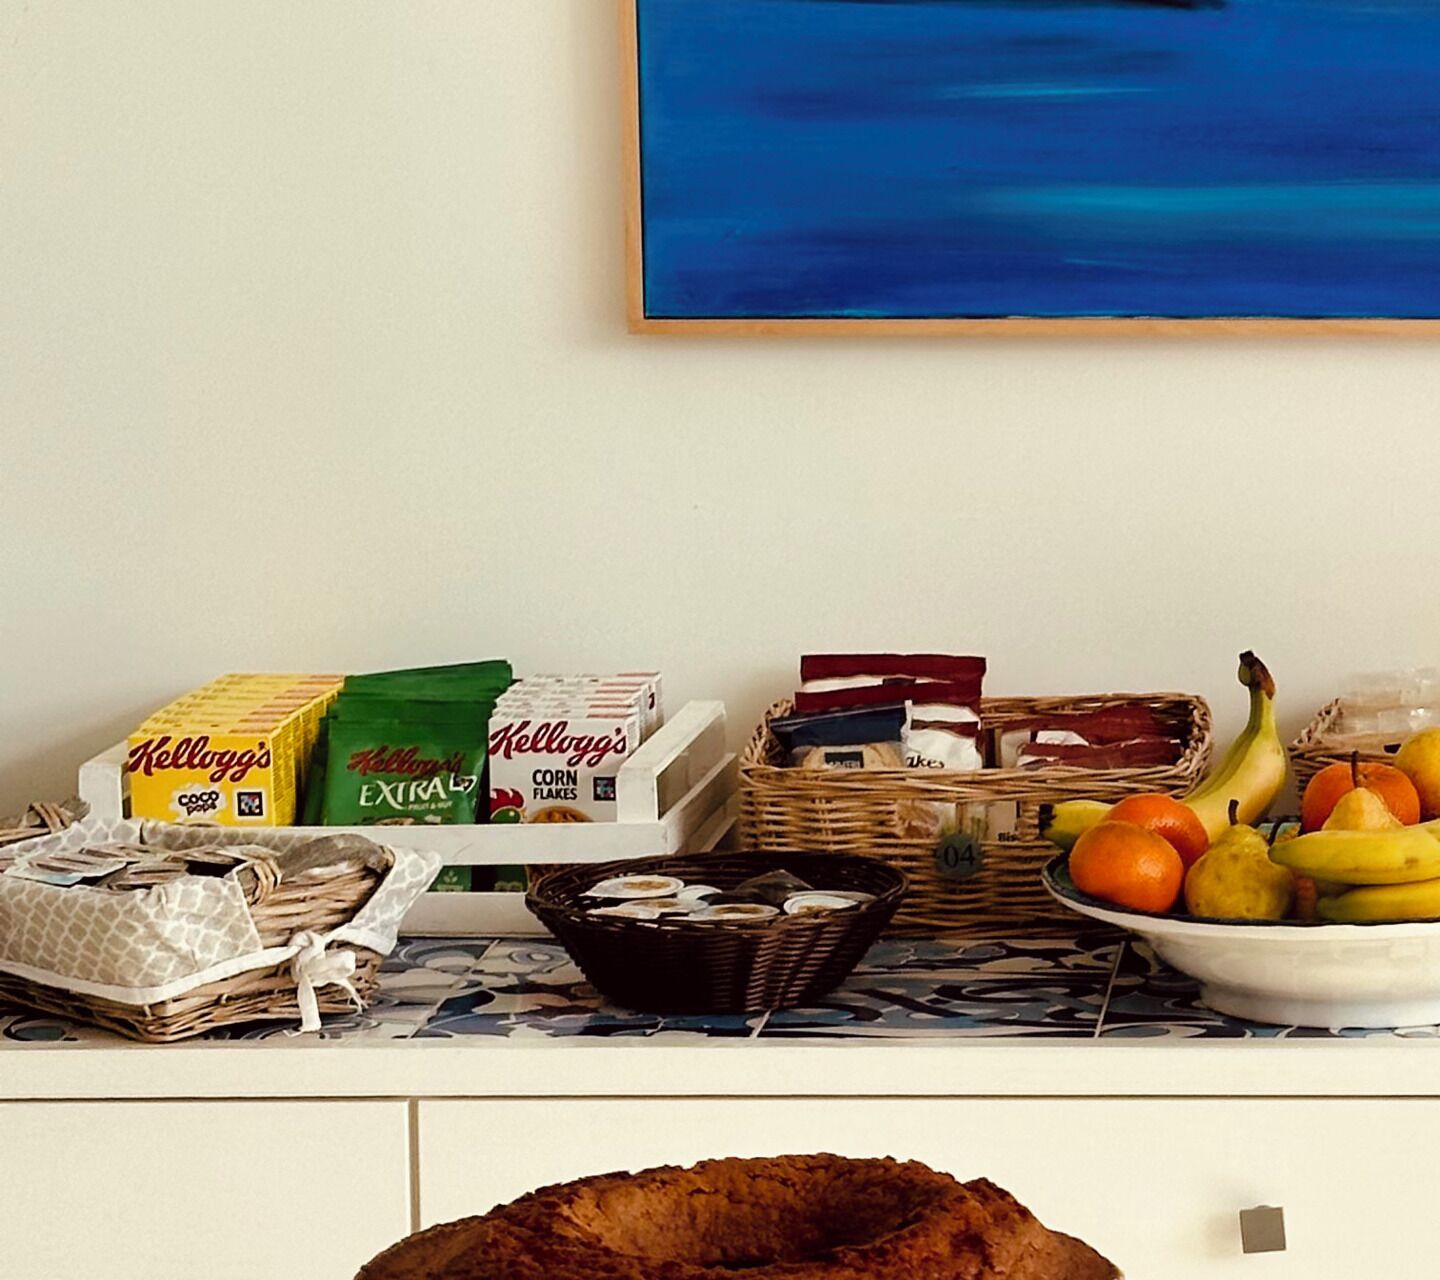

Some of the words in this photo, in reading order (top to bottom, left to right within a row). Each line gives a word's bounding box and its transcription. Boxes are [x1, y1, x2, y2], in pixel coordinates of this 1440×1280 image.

[488, 720, 627, 767] Kellogg's
[128, 736, 271, 782] Kellogg's
[532, 769, 578, 787] CORN
[359, 776, 447, 810] EXTRA
[533, 787, 578, 800] FLAKES
[943, 843, 975, 868] 04
